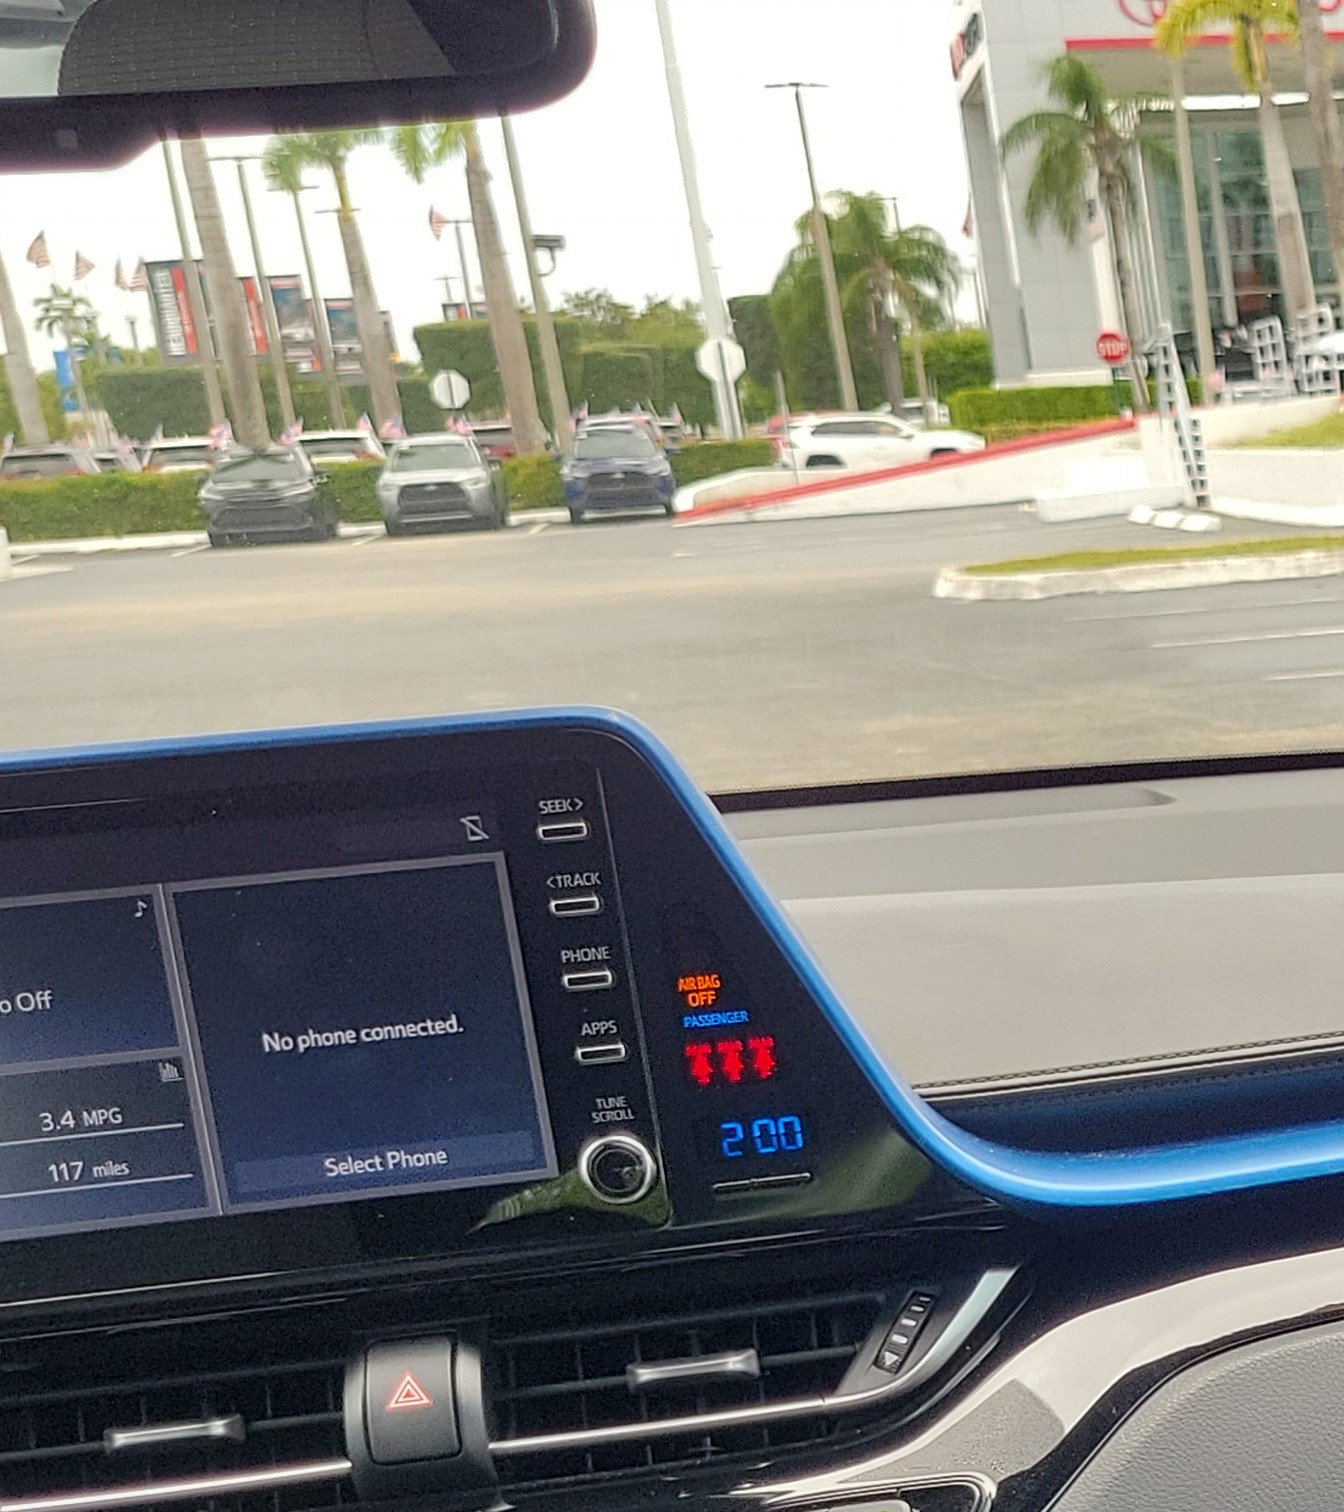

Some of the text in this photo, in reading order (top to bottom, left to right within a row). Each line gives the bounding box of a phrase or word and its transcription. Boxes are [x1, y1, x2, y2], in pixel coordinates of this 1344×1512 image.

[540, 799, 574, 814] SEEK
[555, 872, 602, 888] TRACK
[561, 947, 612, 963] PHONE
[16, 990, 52, 1012] Off
[688, 991, 716, 1007] OFF
[683, 1011, 750, 1028] PASSENGER
[262, 1014, 464, 1053] No phone connected.
[581, 1020, 618, 1036] APPS
[596, 1096, 627, 1108] TUNE
[39, 1107, 123, 1132] 3.4 MPG
[592, 1109, 635, 1123] SCROLL
[49, 1160, 130, 1182] 117 miles
[324, 1149, 448, 1177] Select Phone
